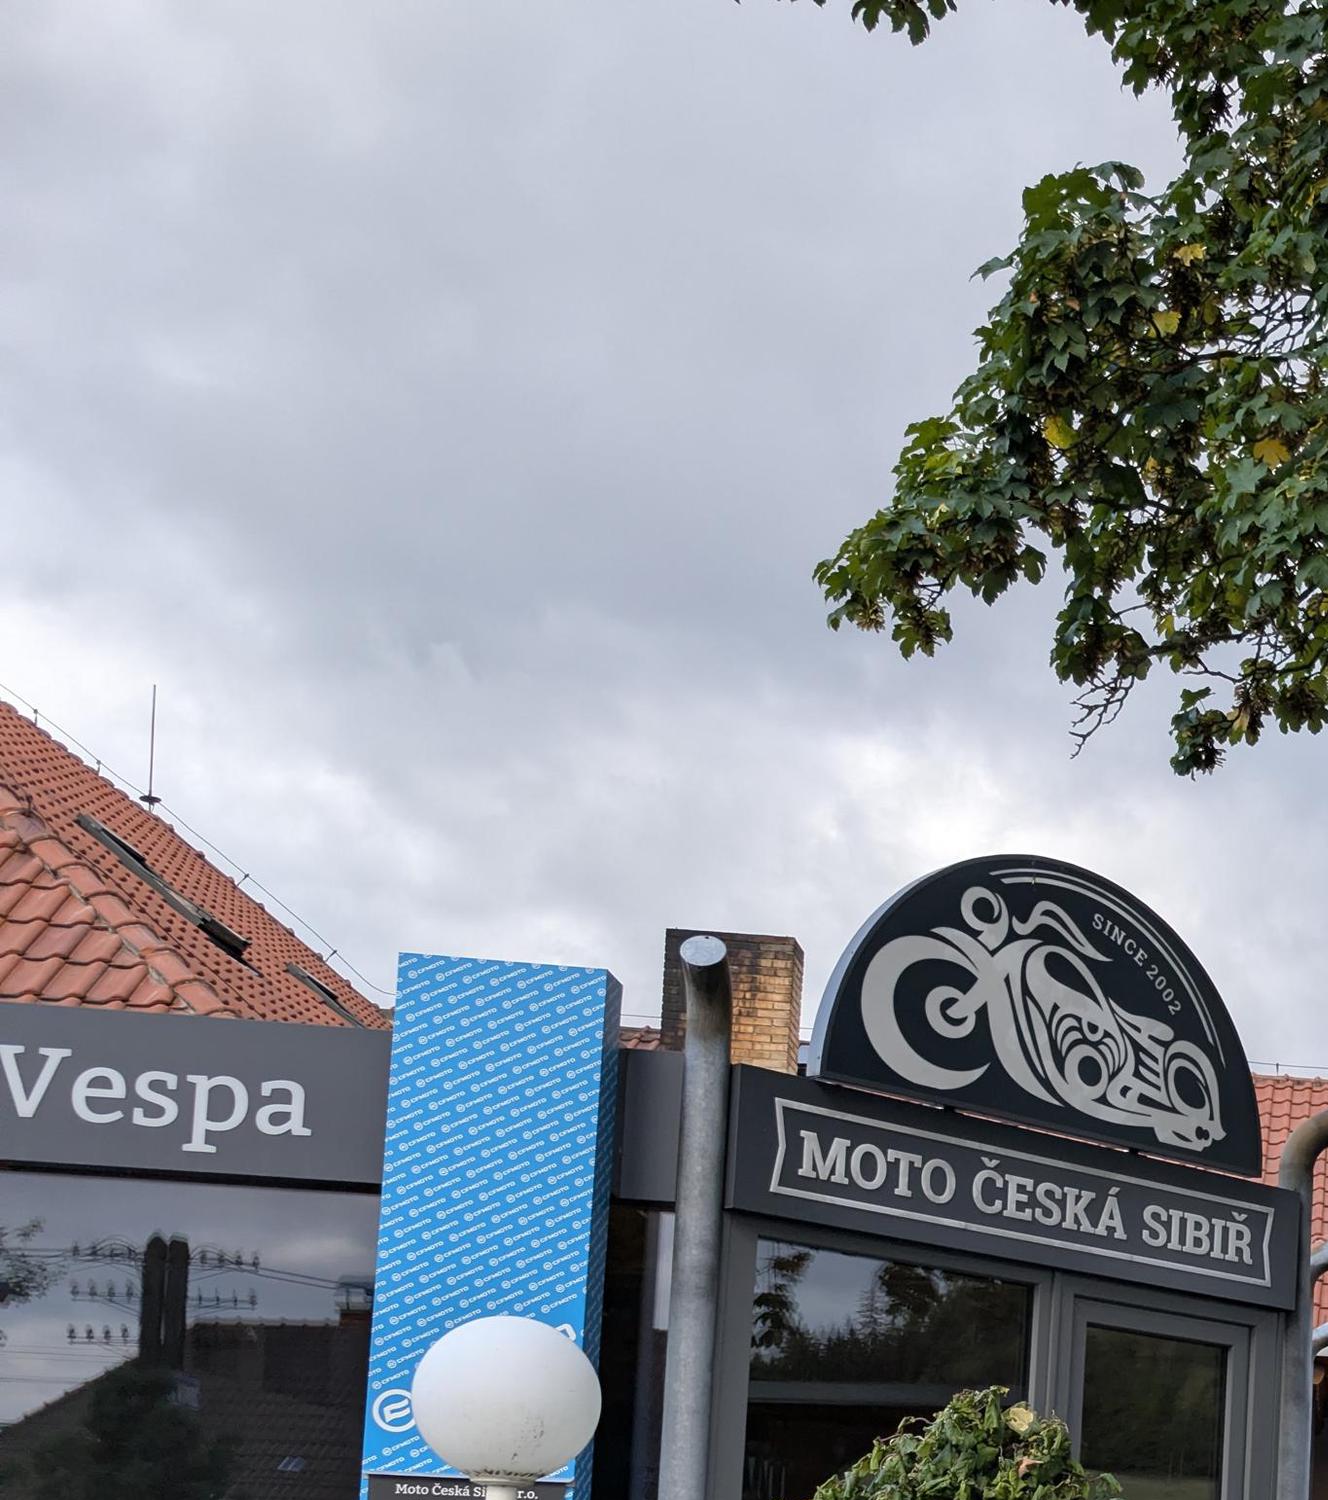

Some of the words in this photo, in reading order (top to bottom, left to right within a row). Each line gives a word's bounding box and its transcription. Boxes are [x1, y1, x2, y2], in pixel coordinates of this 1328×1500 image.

[418, 961, 445, 974] CFMOTO
[445, 963, 472, 976] CFMOTO
[1092, 913, 1148, 966] SINCE
[1146, 964, 1181, 1016] 2002
[499, 968, 526, 982] CFMOTO
[553, 973, 580, 987] CFMOTO
[403, 981, 430, 994] CFMOTO
[457, 986, 485, 999] CFMOTO
[512, 991, 539, 1004] CFMOTO
[538, 993, 566, 1007] CFMOTO
[415, 1003, 443, 1017] CFMOTO
[470, 1008, 497, 1022] CFMOTO
[524, 1013, 551, 1027] CFMOTO
[550, 1016, 578, 1029] CFMOTO
[428, 1026, 455, 1040] CFMOTO
[482, 1031, 510, 1044] CFMOTO
[509, 1033, 537, 1047] CFMOTO
[563, 1038, 590, 1052] CFMOTO
[440, 1049, 468, 1062] CFMOTO
[494, 1054, 522, 1067] CFMOTO
[522, 1056, 549, 1069] CFMOTO
[398, 1067, 426, 1080] CFMOTO
[453, 1071, 480, 1085] CFMOTO
[480, 1074, 508, 1087] CFMOTO
[534, 1078, 562, 1092] CFMOTO
[0, 1045, 312, 1153] Vespa
[411, 1089, 438, 1103] CFMOTO
[465, 1094, 493, 1107] CFMOTO
[492, 1096, 520, 1110] CFMOTO
[546, 1101, 574, 1114] CFMOTO
[423, 1112, 451, 1126] CFMOTO
[450, 1114, 478, 1128] CFMOTO
[505, 1119, 532, 1132] CFMOTO
[559, 1123, 586, 1136] CFMOTO
[436, 1135, 463, 1148] CFMOTO
[463, 1137, 490, 1150] CFMOTO
[517, 1141, 545, 1155] CFMOTO
[394, 1153, 421, 1166] CFMOTO
[421, 1155, 448, 1169] CFMOTO
[476, 1160, 503, 1173] CFMOTO
[530, 1164, 557, 1177] CFMOTO
[557, 1166, 584, 1179] CFMOTO
[434, 1178, 461, 1191] CFMOTO
[488, 1182, 516, 1196] CFMOTO
[542, 1186, 570, 1200] CFMOTO
[797, 1129, 957, 1205] MOTO
[972, 1156, 1128, 1240] ČESKÁ
[1142, 1204, 1254, 1266] SIBIŘ
[391, 1197, 418, 1210] CFMOTO
[446, 1201, 474, 1214] CFMOTO
[500, 1205, 528, 1218] CFMOTO
[528, 1207, 555, 1220] CFMOTO
[404, 1219, 431, 1232] CFMOTO
[459, 1223, 486, 1236] CFMOTO
[513, 1227, 540, 1241] CFMOTO
[540, 1229, 568, 1242] CFMOTO
[416, 1242, 444, 1255] CFMOTO
[471, 1246, 498, 1259] CFMOTO
[498, 1248, 526, 1261] CFMOTO
[552, 1252, 580, 1265] CFMOTO
[429, 1264, 456, 1278] CFMOTO
[484, 1268, 511, 1282] CFMOTO
[511, 1270, 538, 1284] CFMOTO
[386, 1283, 414, 1297] CFMOTO
[442, 1287, 469, 1300] CFMOTO
[469, 1289, 496, 1302] CFMOTO
[523, 1293, 550, 1306] CFMOTO
[427, 1308, 454, 1321] CFMOTO
[395, 1484, 429, 1495] Moto
[431, 1483, 470, 1497] Česká
